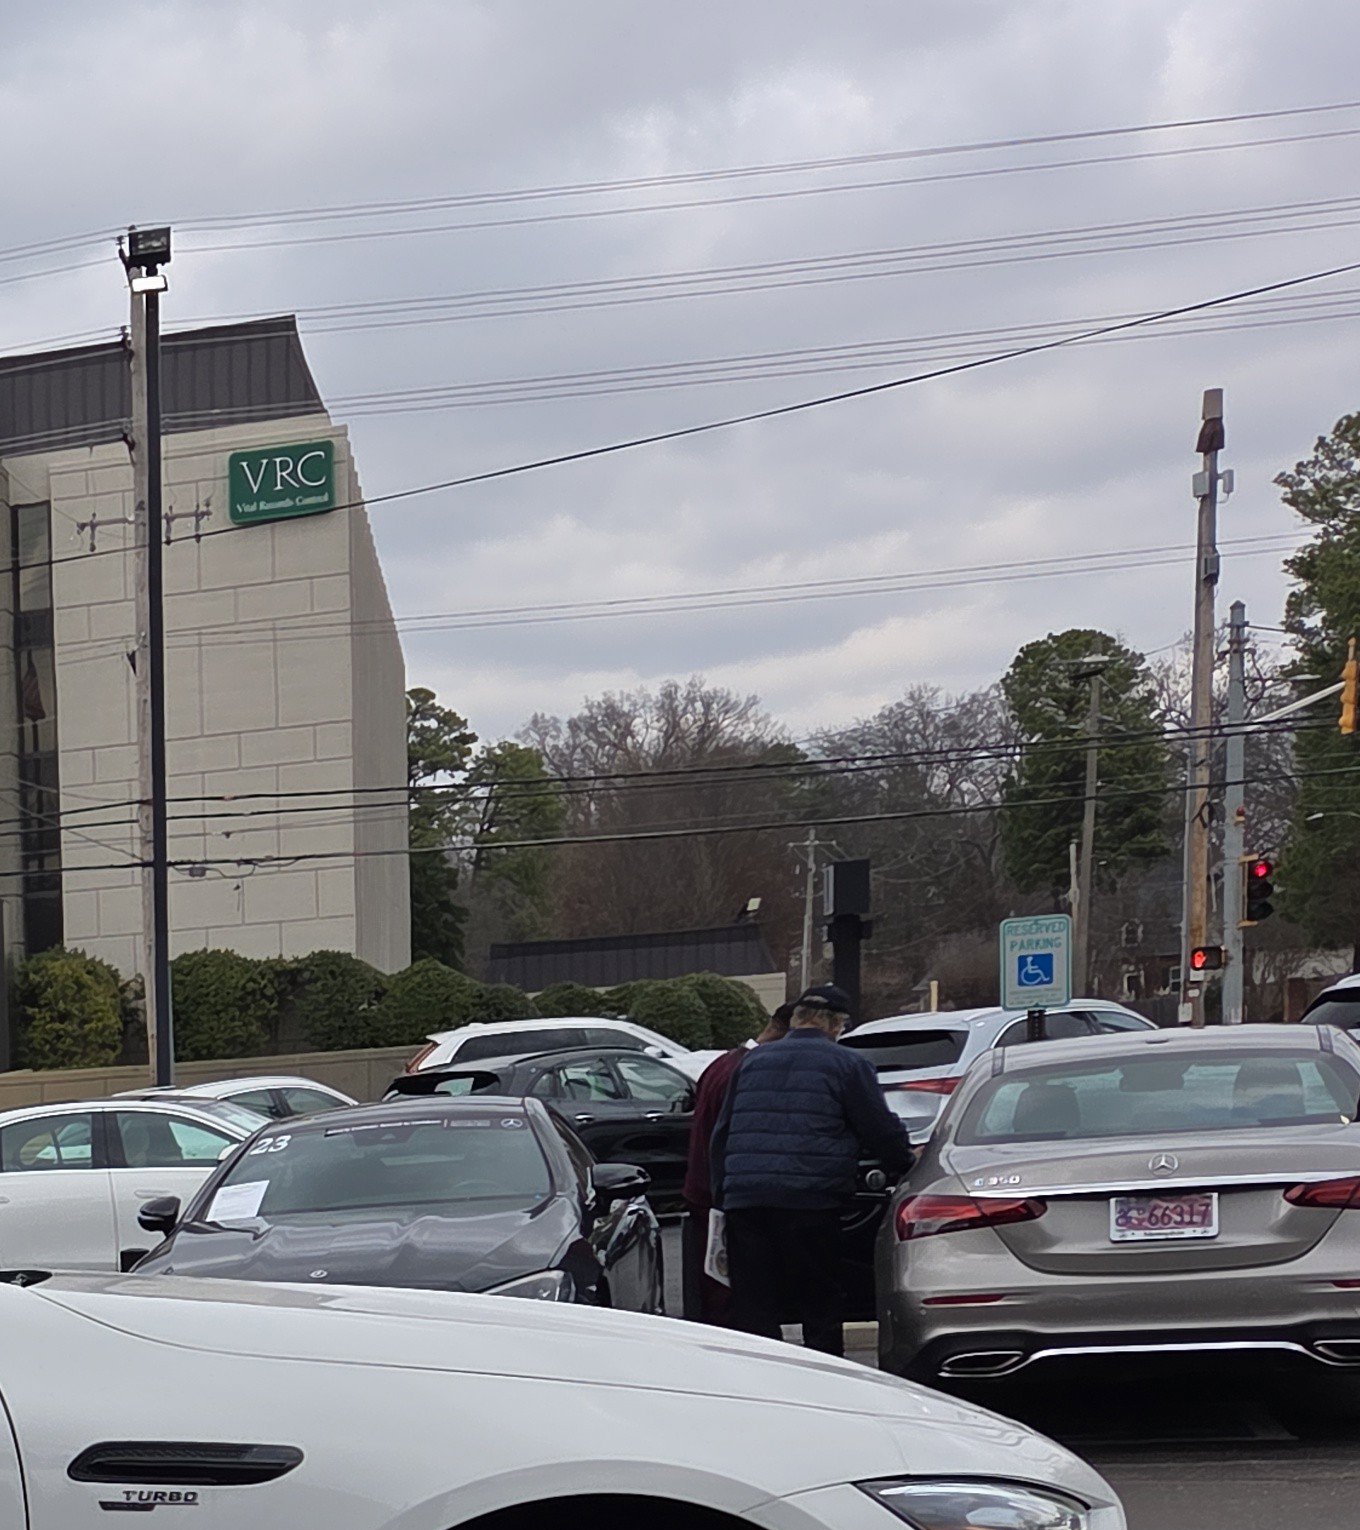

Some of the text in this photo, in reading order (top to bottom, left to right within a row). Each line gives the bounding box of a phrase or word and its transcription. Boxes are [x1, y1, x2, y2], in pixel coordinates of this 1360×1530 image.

[239, 450, 327, 494] VRC
[1006, 921, 1067, 937] RESERVED
[1009, 937, 1062, 951] PARKING
[249, 1134, 292, 1155] 23
[122, 1490, 199, 1502] TURBO
